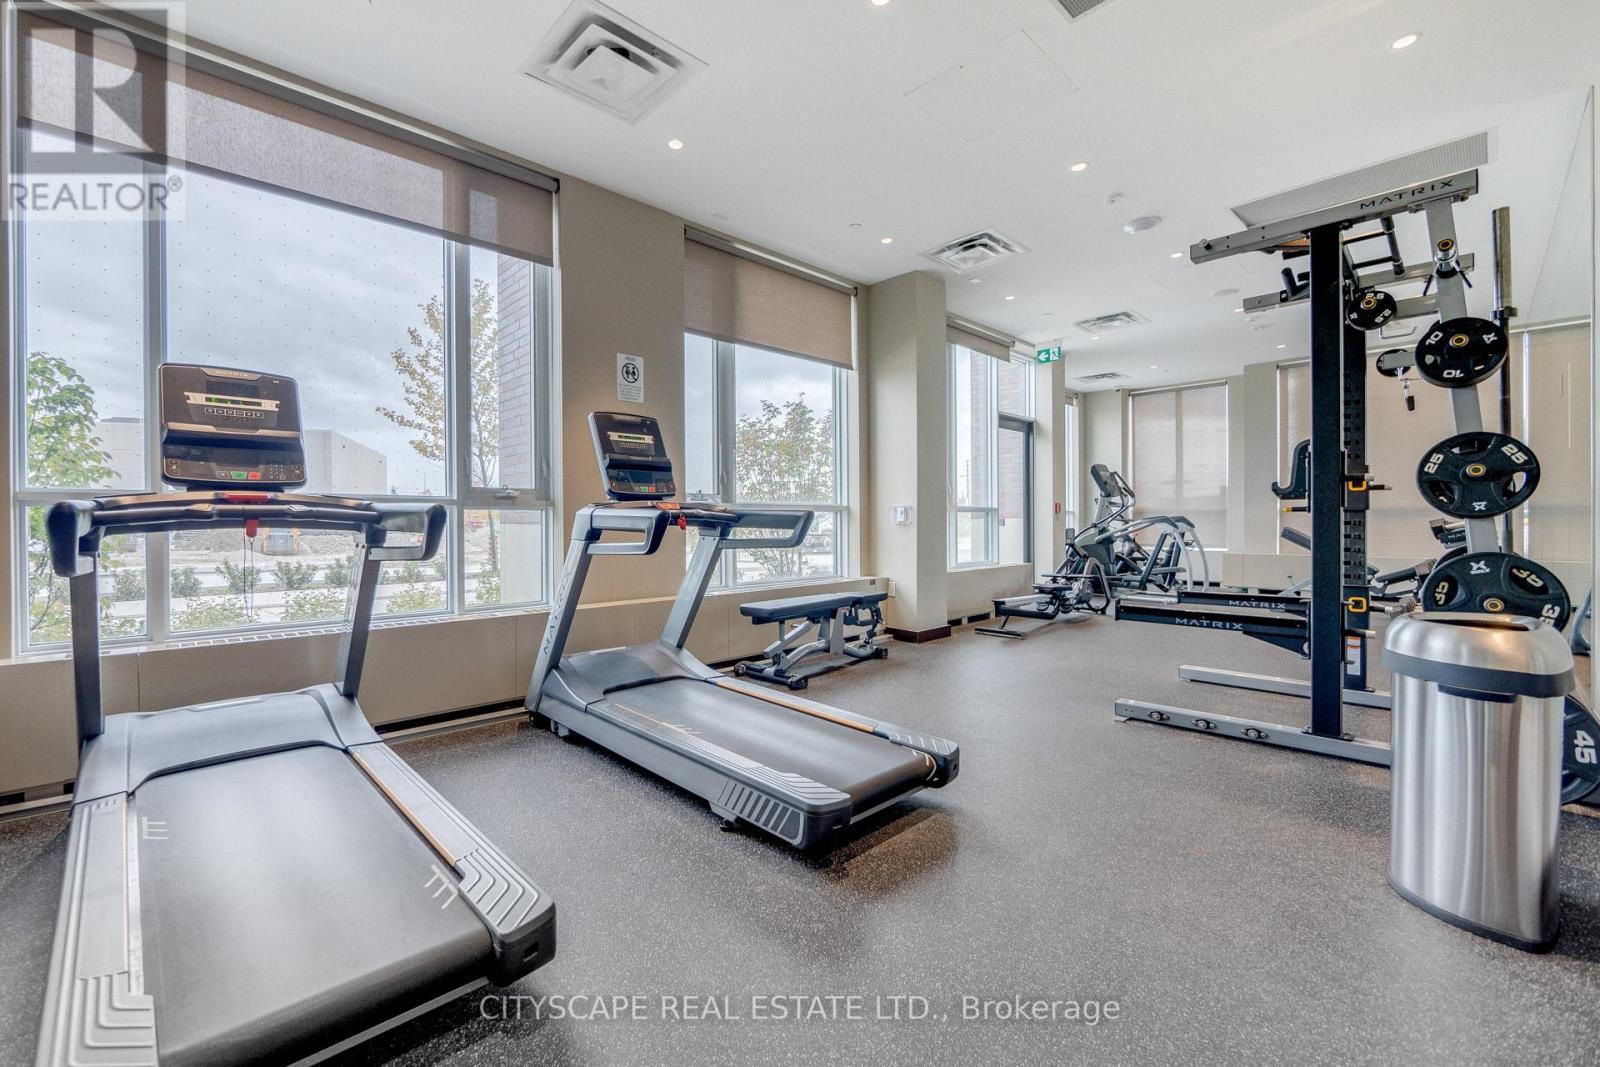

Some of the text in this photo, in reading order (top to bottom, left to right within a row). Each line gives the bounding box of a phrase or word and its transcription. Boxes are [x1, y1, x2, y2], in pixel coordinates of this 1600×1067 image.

[1360, 179, 1453, 209] MATRIX
[1425, 331, 1444, 345] 10
[1442, 369, 1465, 378] 10
[1501, 443, 1528, 464] 25
[1424, 452, 1445, 474] 25
[1228, 600, 1287, 609] MATRIX
[1175, 617, 1244, 630] MATRIX
[1573, 730, 1598, 764] 45
